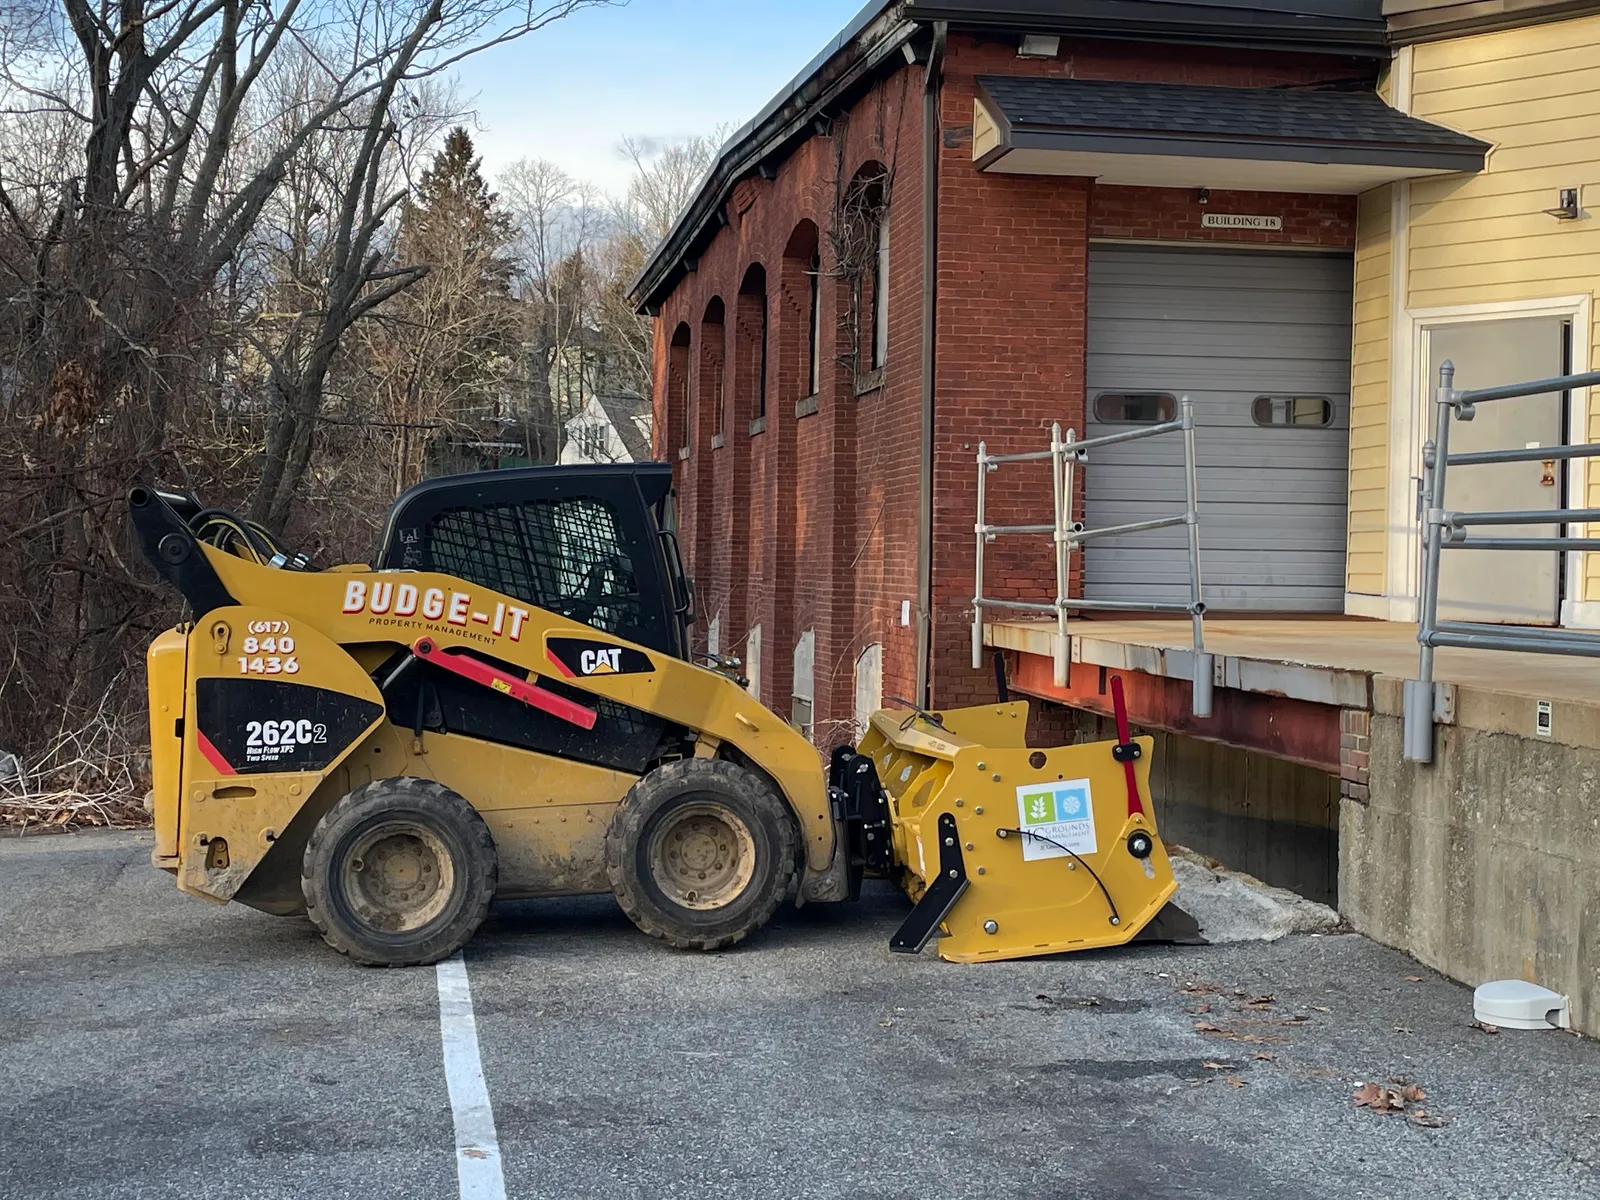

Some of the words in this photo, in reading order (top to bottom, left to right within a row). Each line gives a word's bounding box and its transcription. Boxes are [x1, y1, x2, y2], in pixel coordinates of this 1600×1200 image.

[1208, 216, 1260, 227] BUILDING
[1264, 218, 1276, 227] 18
[342, 580, 529, 642] BUDGE-IT
[247, 620, 290, 635] (617)
[369, 617, 423, 629] PROPERTY
[425, 623, 497, 645] MANAGEMENT
[243, 637, 295, 654] 840
[237, 656, 300, 674] 1436
[580, 648, 622, 675] CAT
[1045, 823, 1090, 834] GROUNDS
